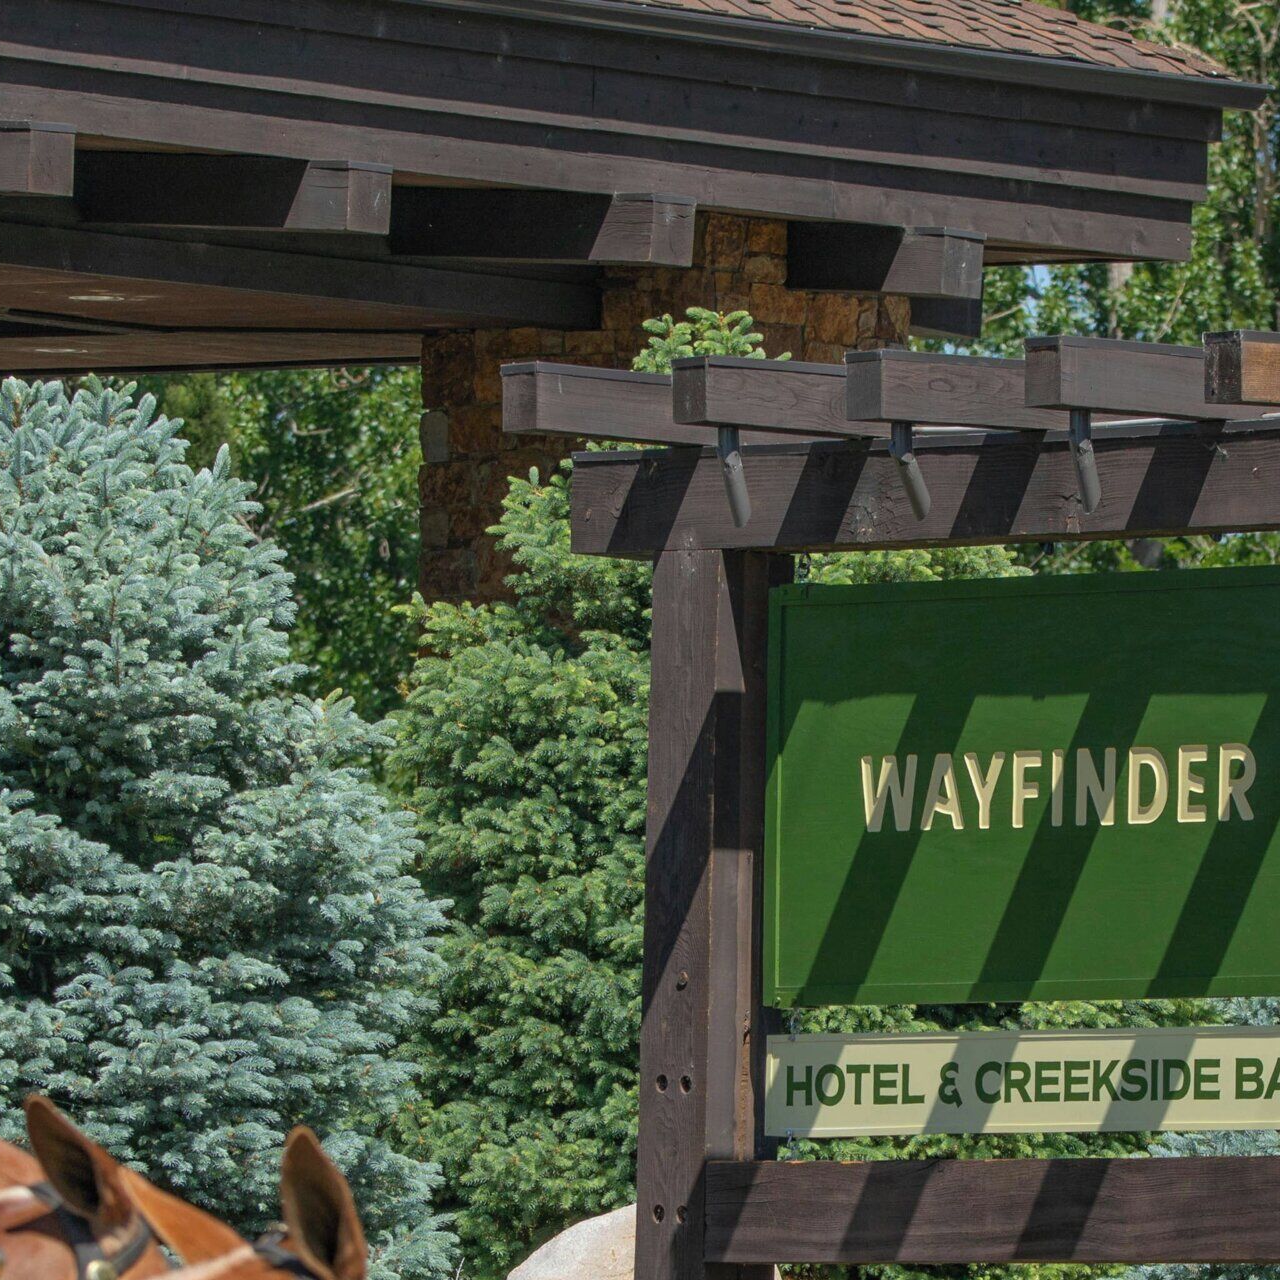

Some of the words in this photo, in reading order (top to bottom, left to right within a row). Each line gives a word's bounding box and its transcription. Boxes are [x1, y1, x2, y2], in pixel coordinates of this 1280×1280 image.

[860, 742, 1257, 832] WAYFINDER
[786, 1063, 925, 1107] HOTEL
[939, 1061, 963, 1108] &
[975, 1059, 1221, 1104] CREEKSIDE
